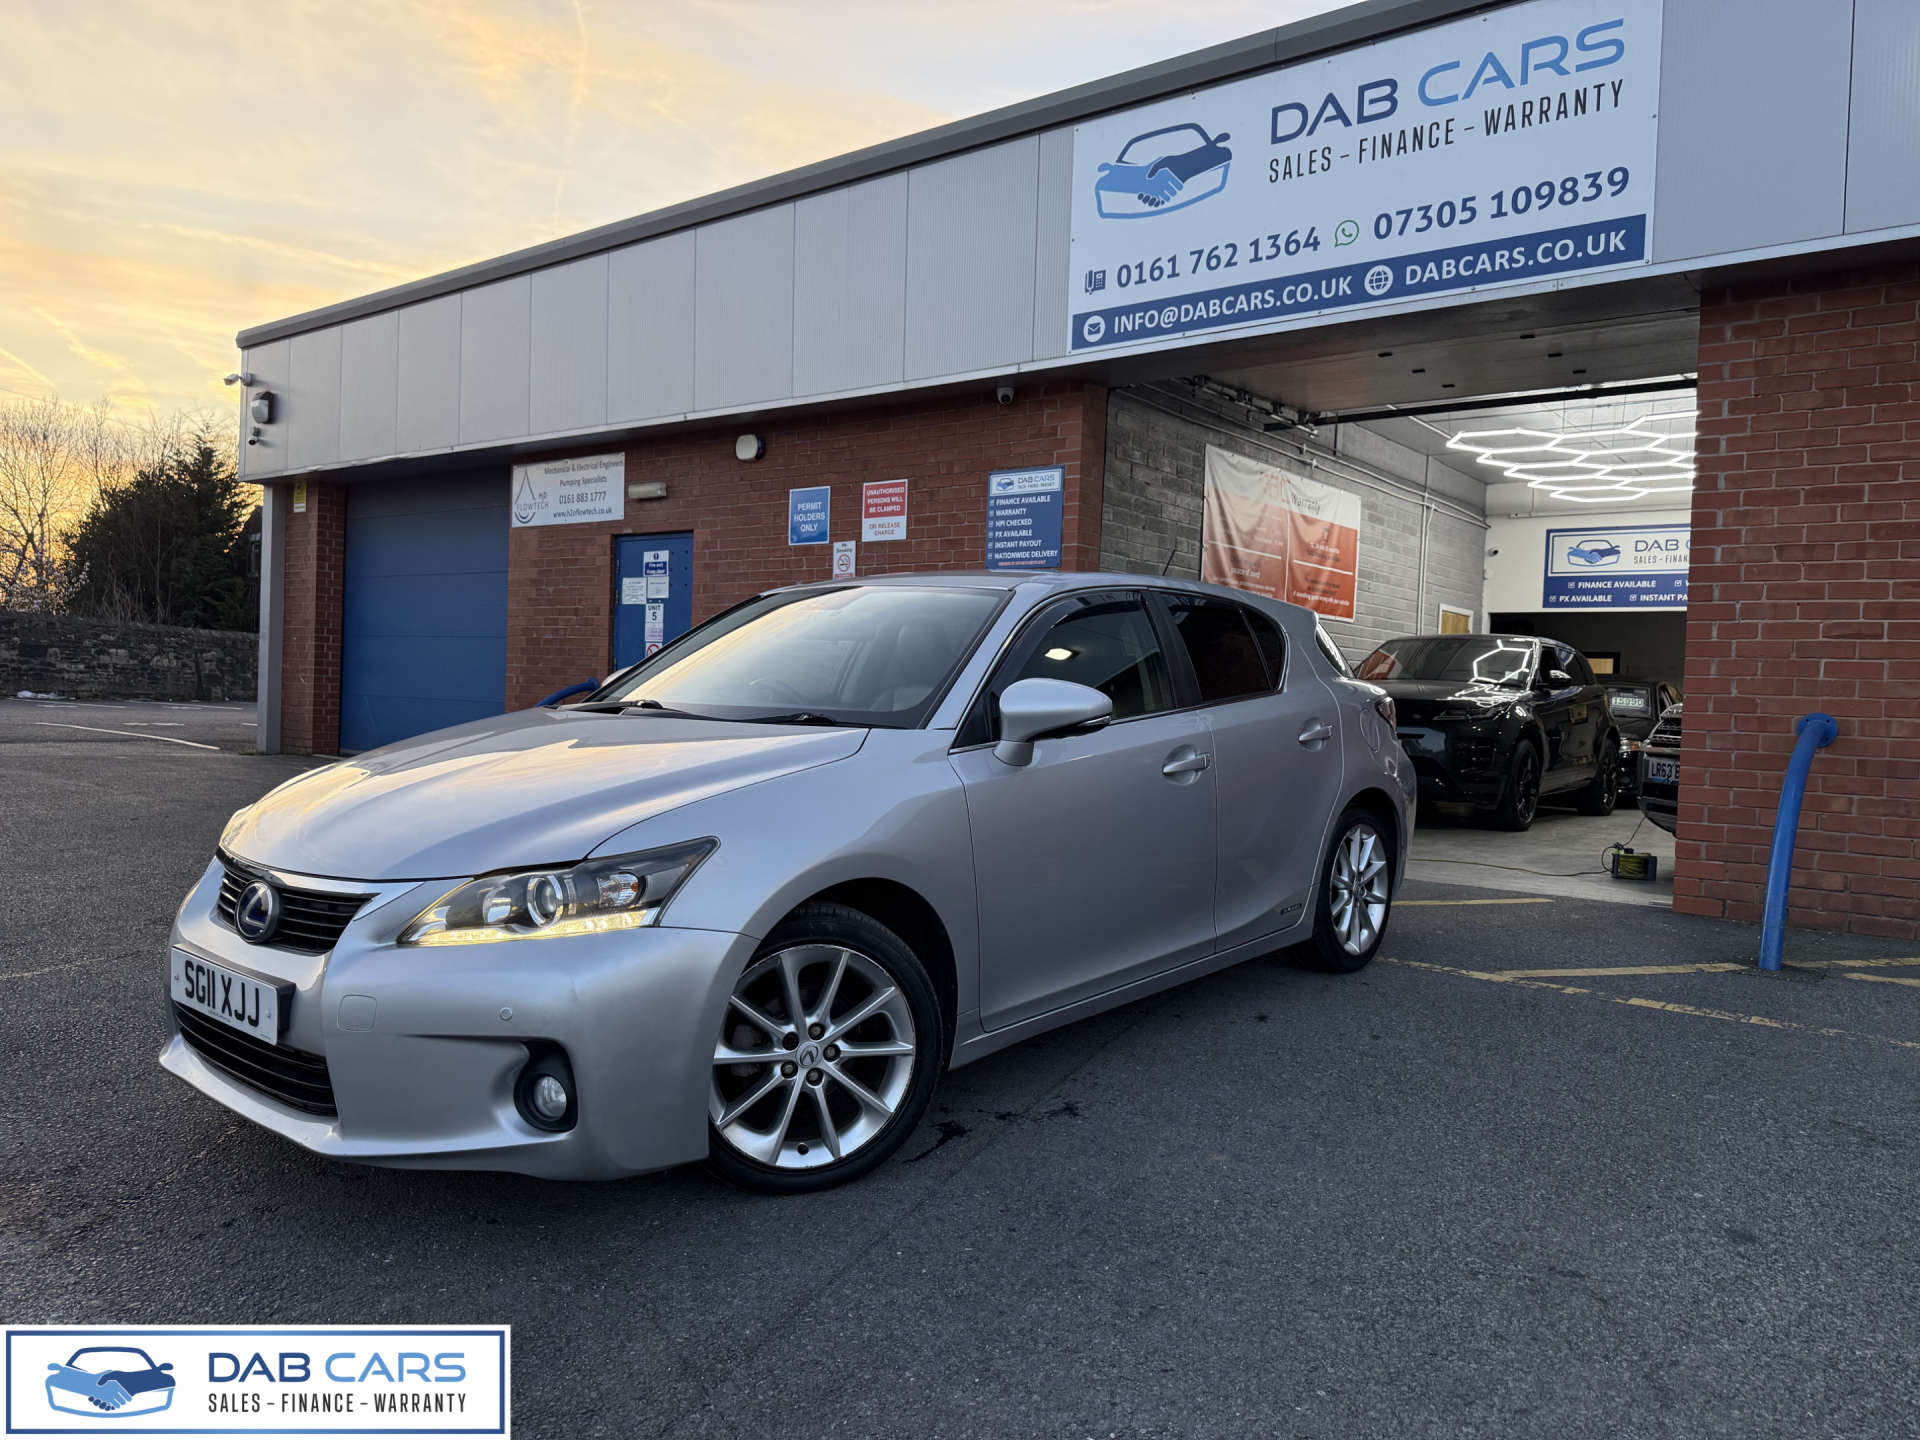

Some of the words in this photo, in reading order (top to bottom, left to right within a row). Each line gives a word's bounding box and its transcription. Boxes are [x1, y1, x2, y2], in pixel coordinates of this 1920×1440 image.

[1270, 78, 1399, 145] DAB
[1418, 18, 1625, 107] CARS
[1268, 146, 1332, 184] SALES
[1358, 118, 1456, 165] FINANCE
[1483, 78, 1624, 137] WARRANTY
[1373, 195, 1478, 241] 07305
[1489, 166, 1630, 219] 109839
[1116, 254, 1181, 289] 0161
[1189, 242, 1239, 275] 762
[1248, 226, 1321, 264] 1364
[1404, 228, 1627, 287] DABCARS.CO.UK
[1113, 275, 1353, 335] INFO@DABCARS.CO.UK
[797, 501, 822, 511] PERMIT
[995, 497, 1020, 507] FINANCE
[1021, 495, 1051, 504] AVAILABLE
[793, 511, 826, 522] HOLDERS
[995, 508, 1027, 517] WARRANTY
[799, 523, 818, 533] ONLY
[1006, 518, 1033, 527] CHECKED
[1003, 529, 1033, 538] AVAILABLE
[994, 541, 1018, 549] INSTANT
[1019, 539, 1042, 548] PAYOUT
[1634, 539, 1679, 552] DAB
[994, 551, 1031, 560] NATIONWIDE
[1031, 549, 1058, 559] DELIVERY
[1633, 554, 1657, 564] SALES
[1665, 553, 1688, 564] FINAN
[1578, 580, 1612, 589] FINANCE
[1613, 580, 1657, 588] AVAILABLE
[1570, 594, 1613, 603] AVAILABLE
[1640, 593, 1676, 602] INSTANT
[220, 974, 260, 1028] XJJ
